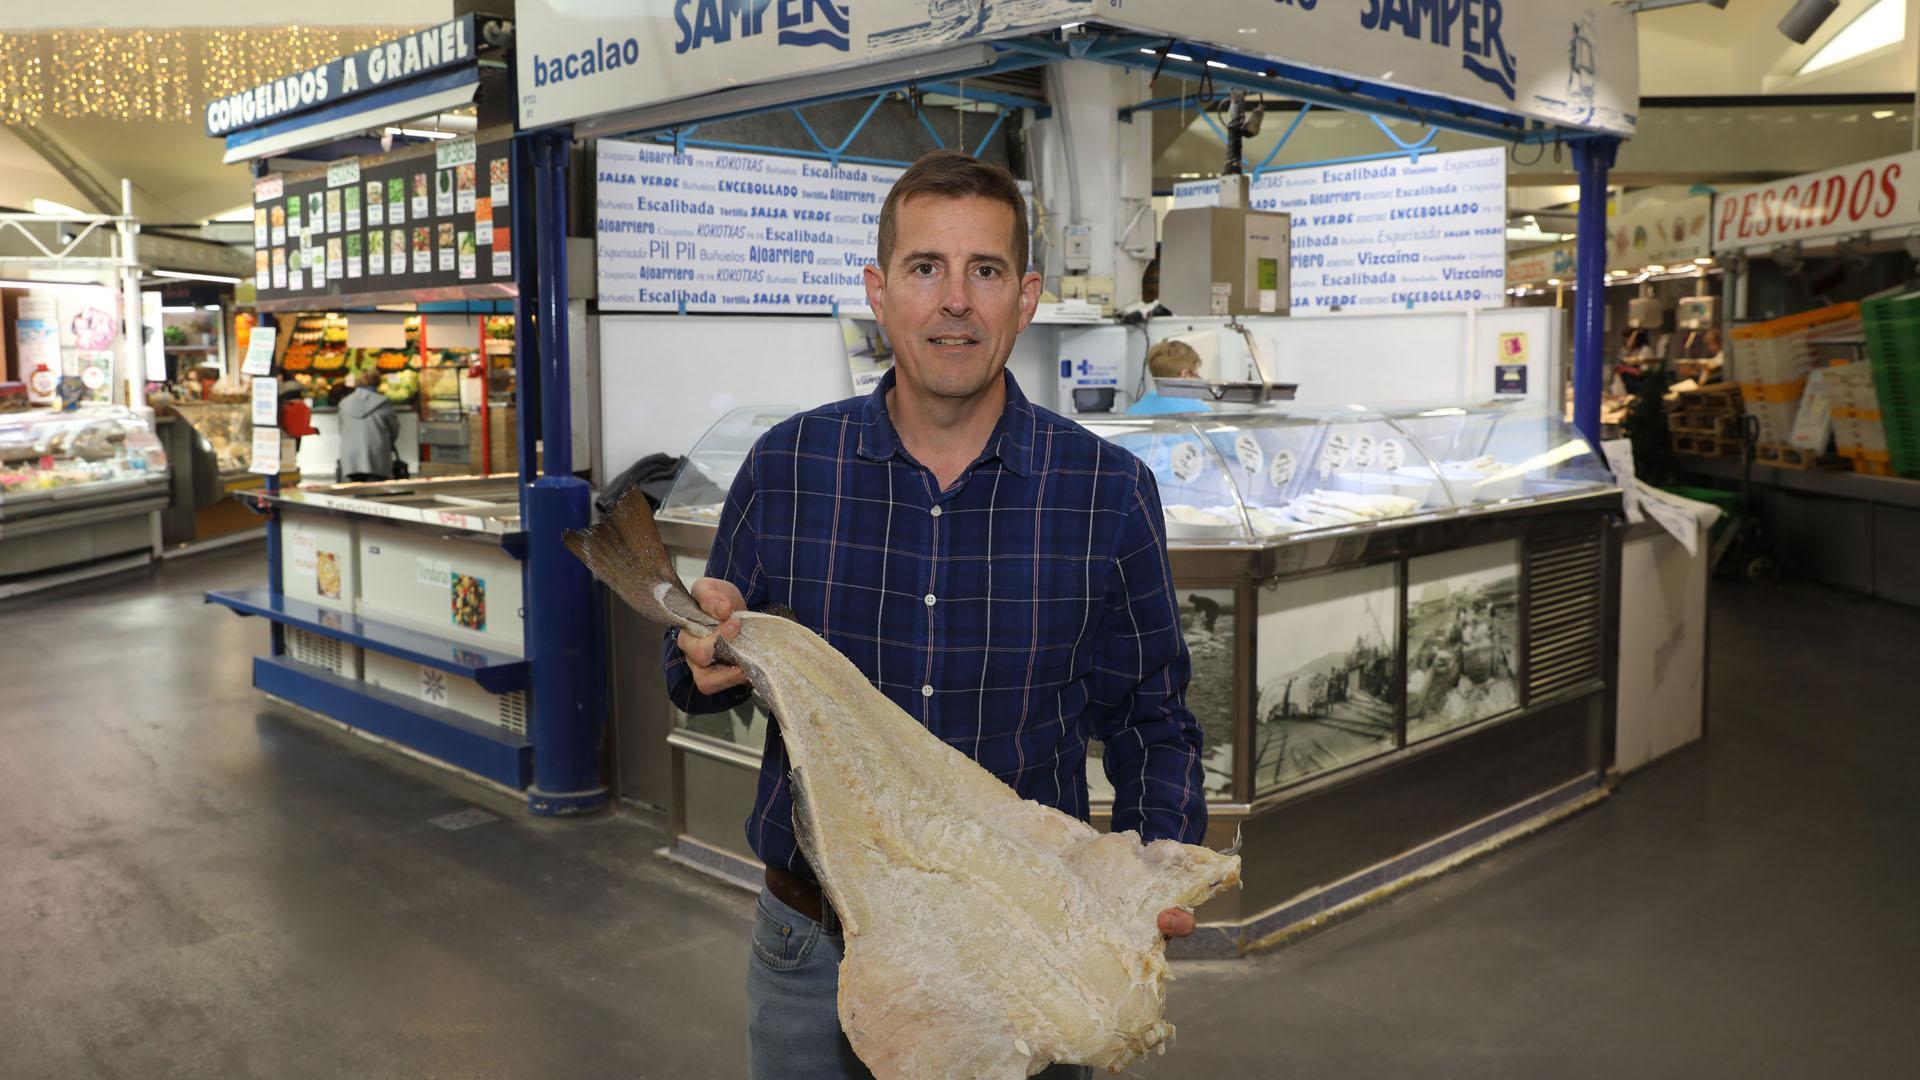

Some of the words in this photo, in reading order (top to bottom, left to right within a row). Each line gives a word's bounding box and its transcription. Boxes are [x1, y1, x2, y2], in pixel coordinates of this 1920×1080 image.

[534, 38, 639, 88] bacalao
[208, 65, 327, 132] CONGELADOS
[342, 57, 357, 94] A
[368, 20, 468, 83] GRANEL
[716, 156, 763, 172] KOKOTXAS
[802, 164, 868, 182] Escalibada
[1323, 165, 1397, 184] Escalibada
[599, 172, 636, 184] SALSA
[641, 175, 679, 187] VERDE
[718, 180, 798, 197] ENCEBOLLADO
[830, 188, 876, 203] Ajoarriero
[1310, 190, 1360, 206] Ajoarriero
[1396, 184, 1457, 198] Escalibada
[638, 196, 714, 214] Escalibada
[720, 208, 748, 217] Tortilla
[750, 207, 788, 218] SALSA
[793, 210, 831, 221] VERDE
[1718, 162, 1901, 241] PESCADOS
[1313, 214, 1353, 226] VERDE
[1391, 202, 1478, 220] ENCEBOLLADO
[598, 219, 654, 234] Ajoarriero
[697, 224, 745, 240] KOKOTXAS
[766, 228, 833, 244] Escalibada
[650, 241, 669, 260] Pil
[676, 242, 695, 260] Pil
[700, 249, 746, 262] Buñuelos
[750, 246, 814, 264] Ajoarriero
[844, 252, 879, 267] Vizca
[1358, 251, 1419, 265] Vizcaína
[640, 266, 694, 281] Ajoarriero
[716, 269, 764, 283] KOKOTXAS
[1322, 272, 1396, 286] Escalibada
[1442, 267, 1503, 281] Vizcaína
[639, 288, 716, 304] Escalibada
[722, 295, 750, 304] Tortilla
[753, 292, 790, 304] SALSA
[795, 294, 834, 305] VERDE
[1316, 295, 1356, 306] VERDE
[1391, 290, 1481, 304] ENCEBOLLADO
